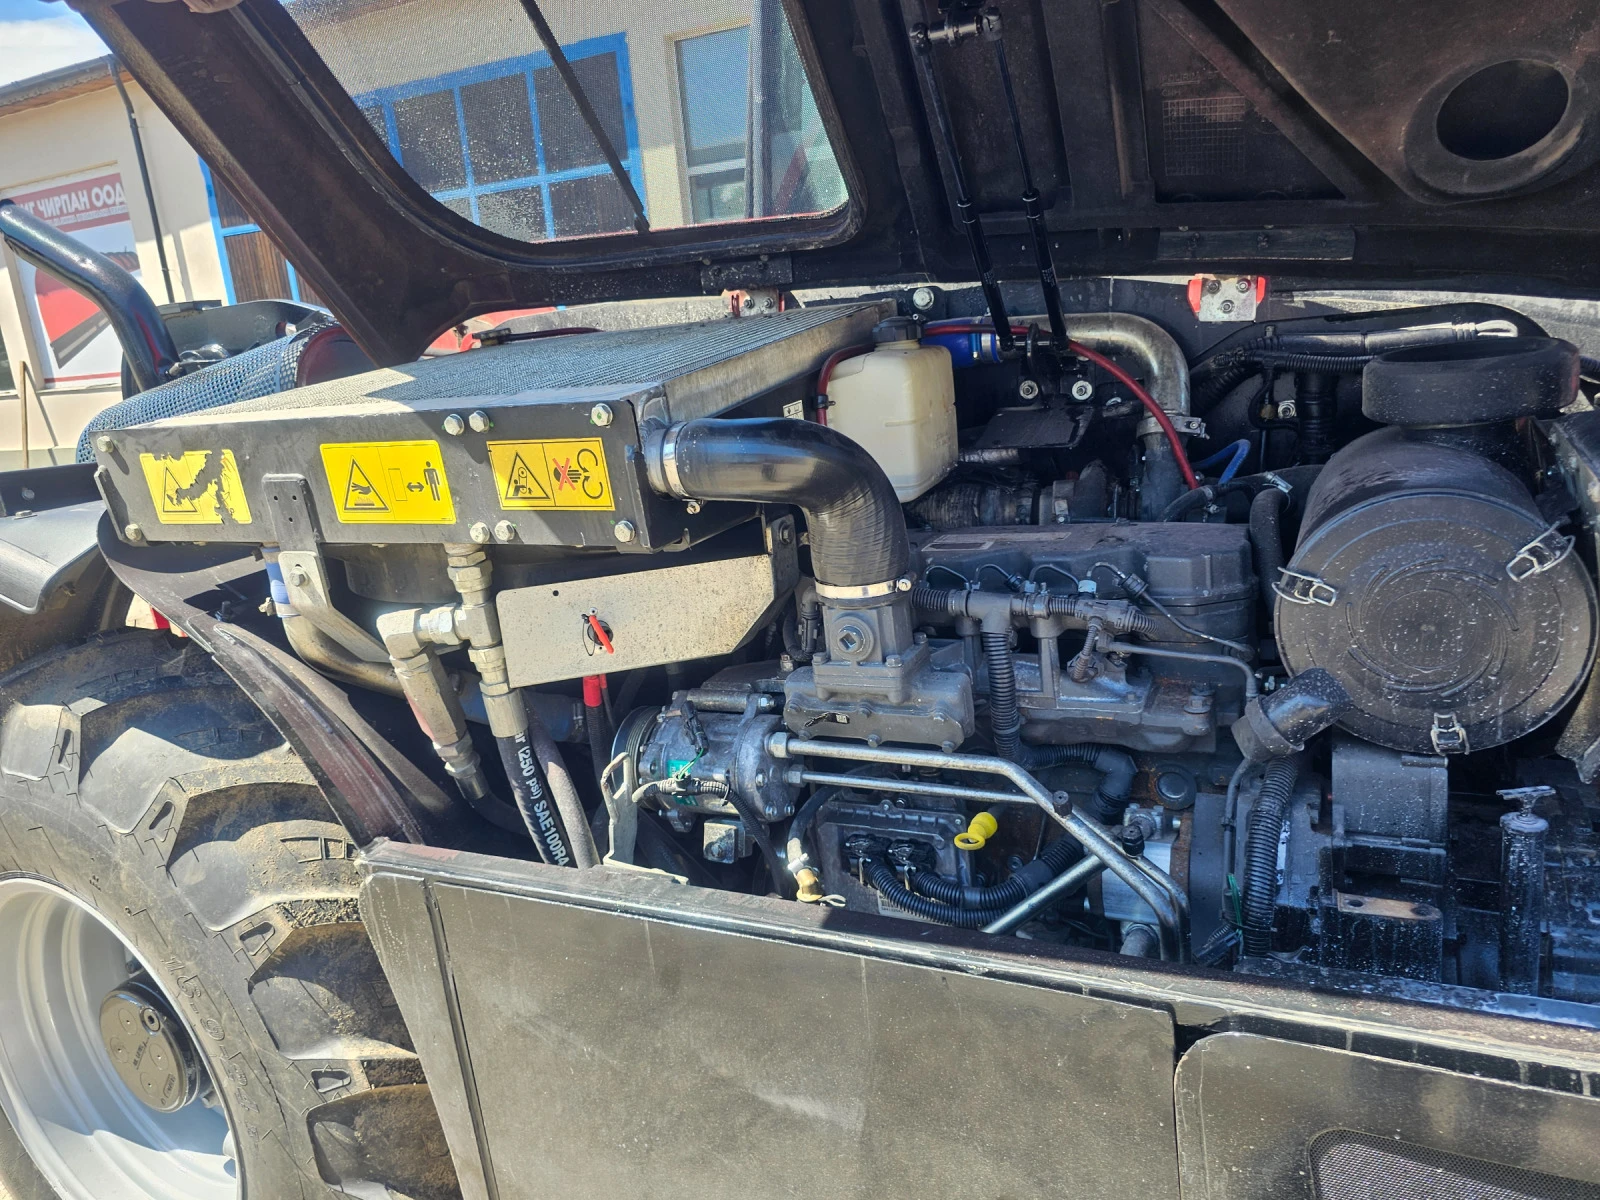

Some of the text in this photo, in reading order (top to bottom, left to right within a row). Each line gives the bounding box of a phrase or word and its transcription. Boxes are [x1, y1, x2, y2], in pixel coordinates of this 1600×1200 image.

[37, 189, 91, 218] ЧИРПАН
[91, 181, 126, 208] ООД
[517, 745, 536, 777] (250
[525, 776, 543, 800] psi)
